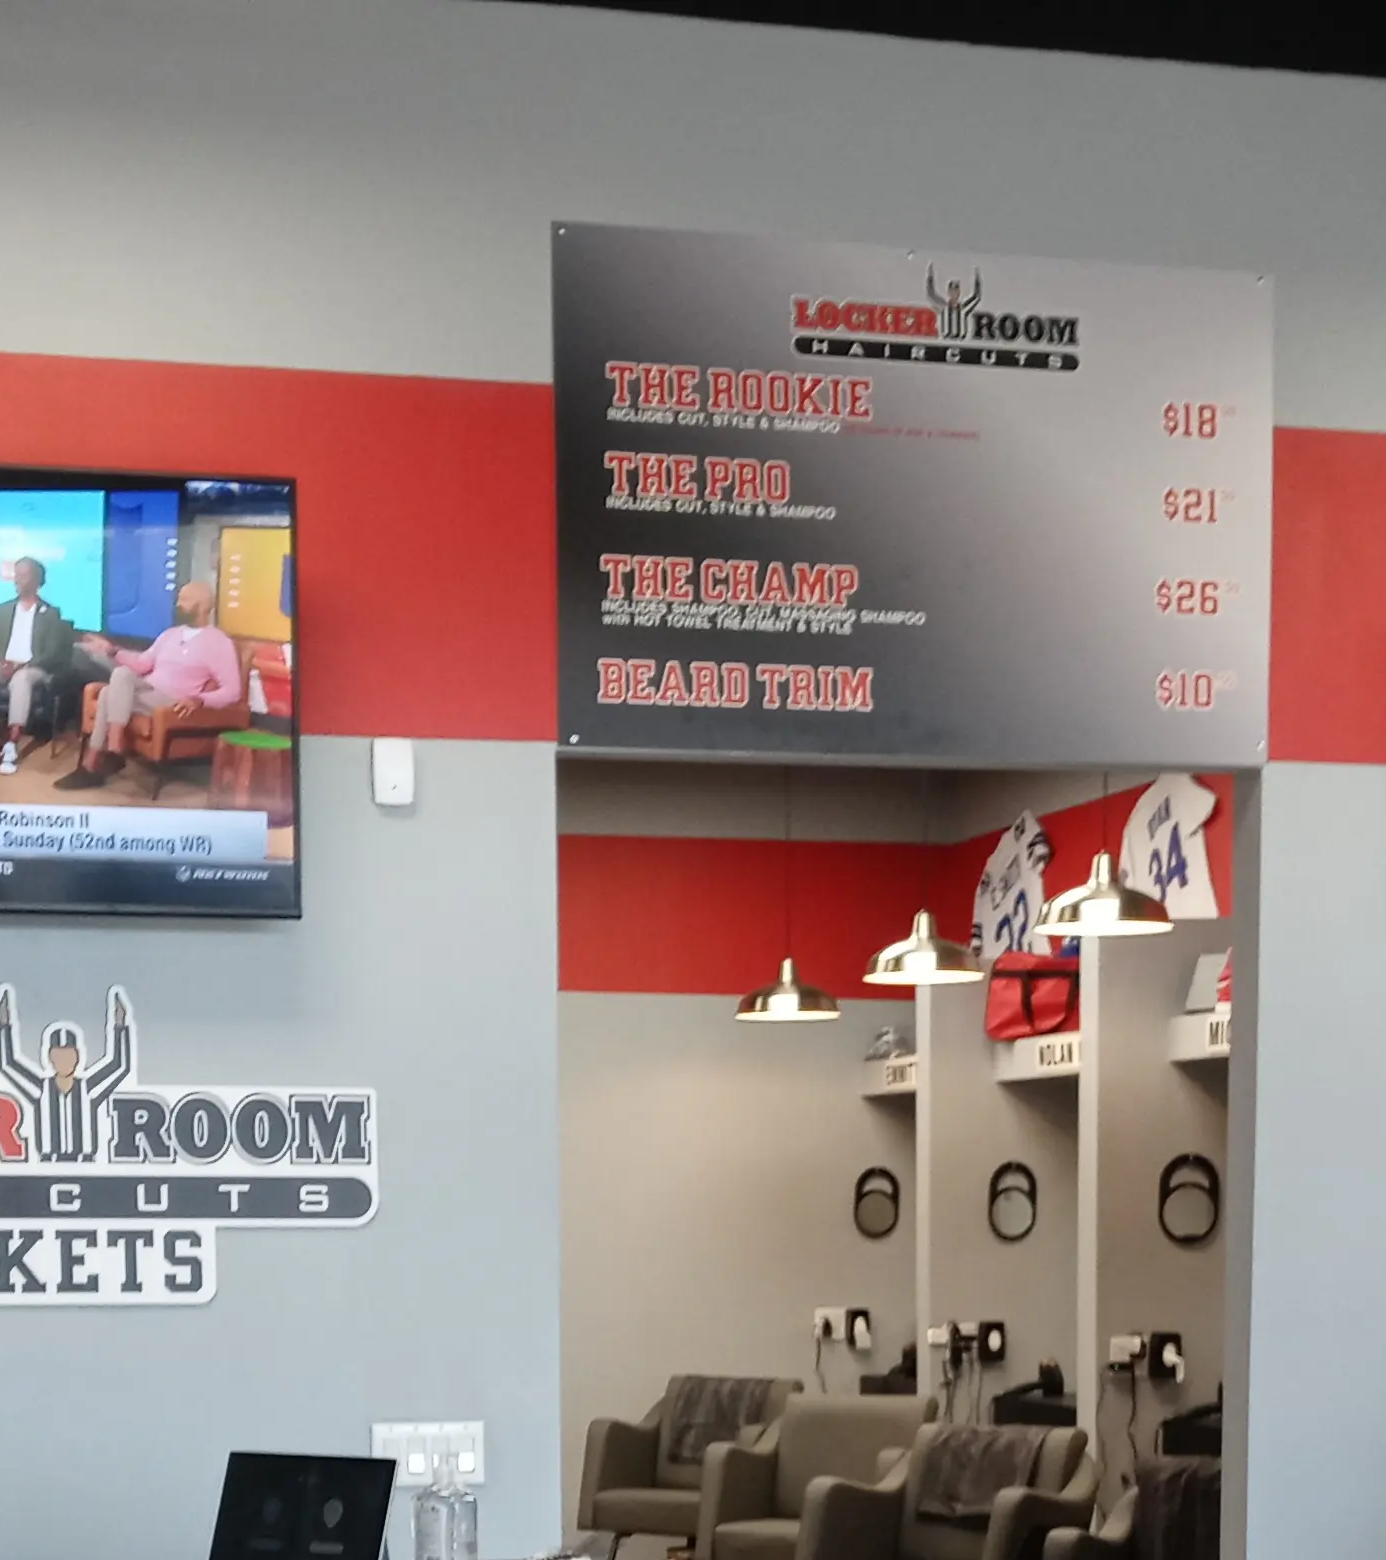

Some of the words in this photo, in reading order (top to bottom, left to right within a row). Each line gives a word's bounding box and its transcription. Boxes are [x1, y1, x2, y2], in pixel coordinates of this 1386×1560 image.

[793, 298, 939, 337] LOCKER
[972, 311, 1079, 345] ROOM
[811, 337, 1064, 370] HAIRCUTS
[606, 361, 699, 410] THE
[707, 367, 873, 422] ROOKIE
[1162, 402, 1217, 439] $18
[606, 405, 673, 425] INCLUDES
[712, 412, 755, 430] STYLE
[604, 450, 698, 499] THE
[704, 456, 791, 504] PRO
[1162, 488, 1218, 523] $21
[600, 553, 694, 602] THE
[699, 557, 859, 609] CHAMP
[1156, 578, 1219, 616] $26
[597, 657, 750, 709] BEARD
[756, 662, 874, 713] TRIM
[1157, 671, 1213, 709] $10
[2, 831, 64, 853] Sunday
[120, 837, 176, 855] among
[108, 1090, 376, 1166] ROOM
